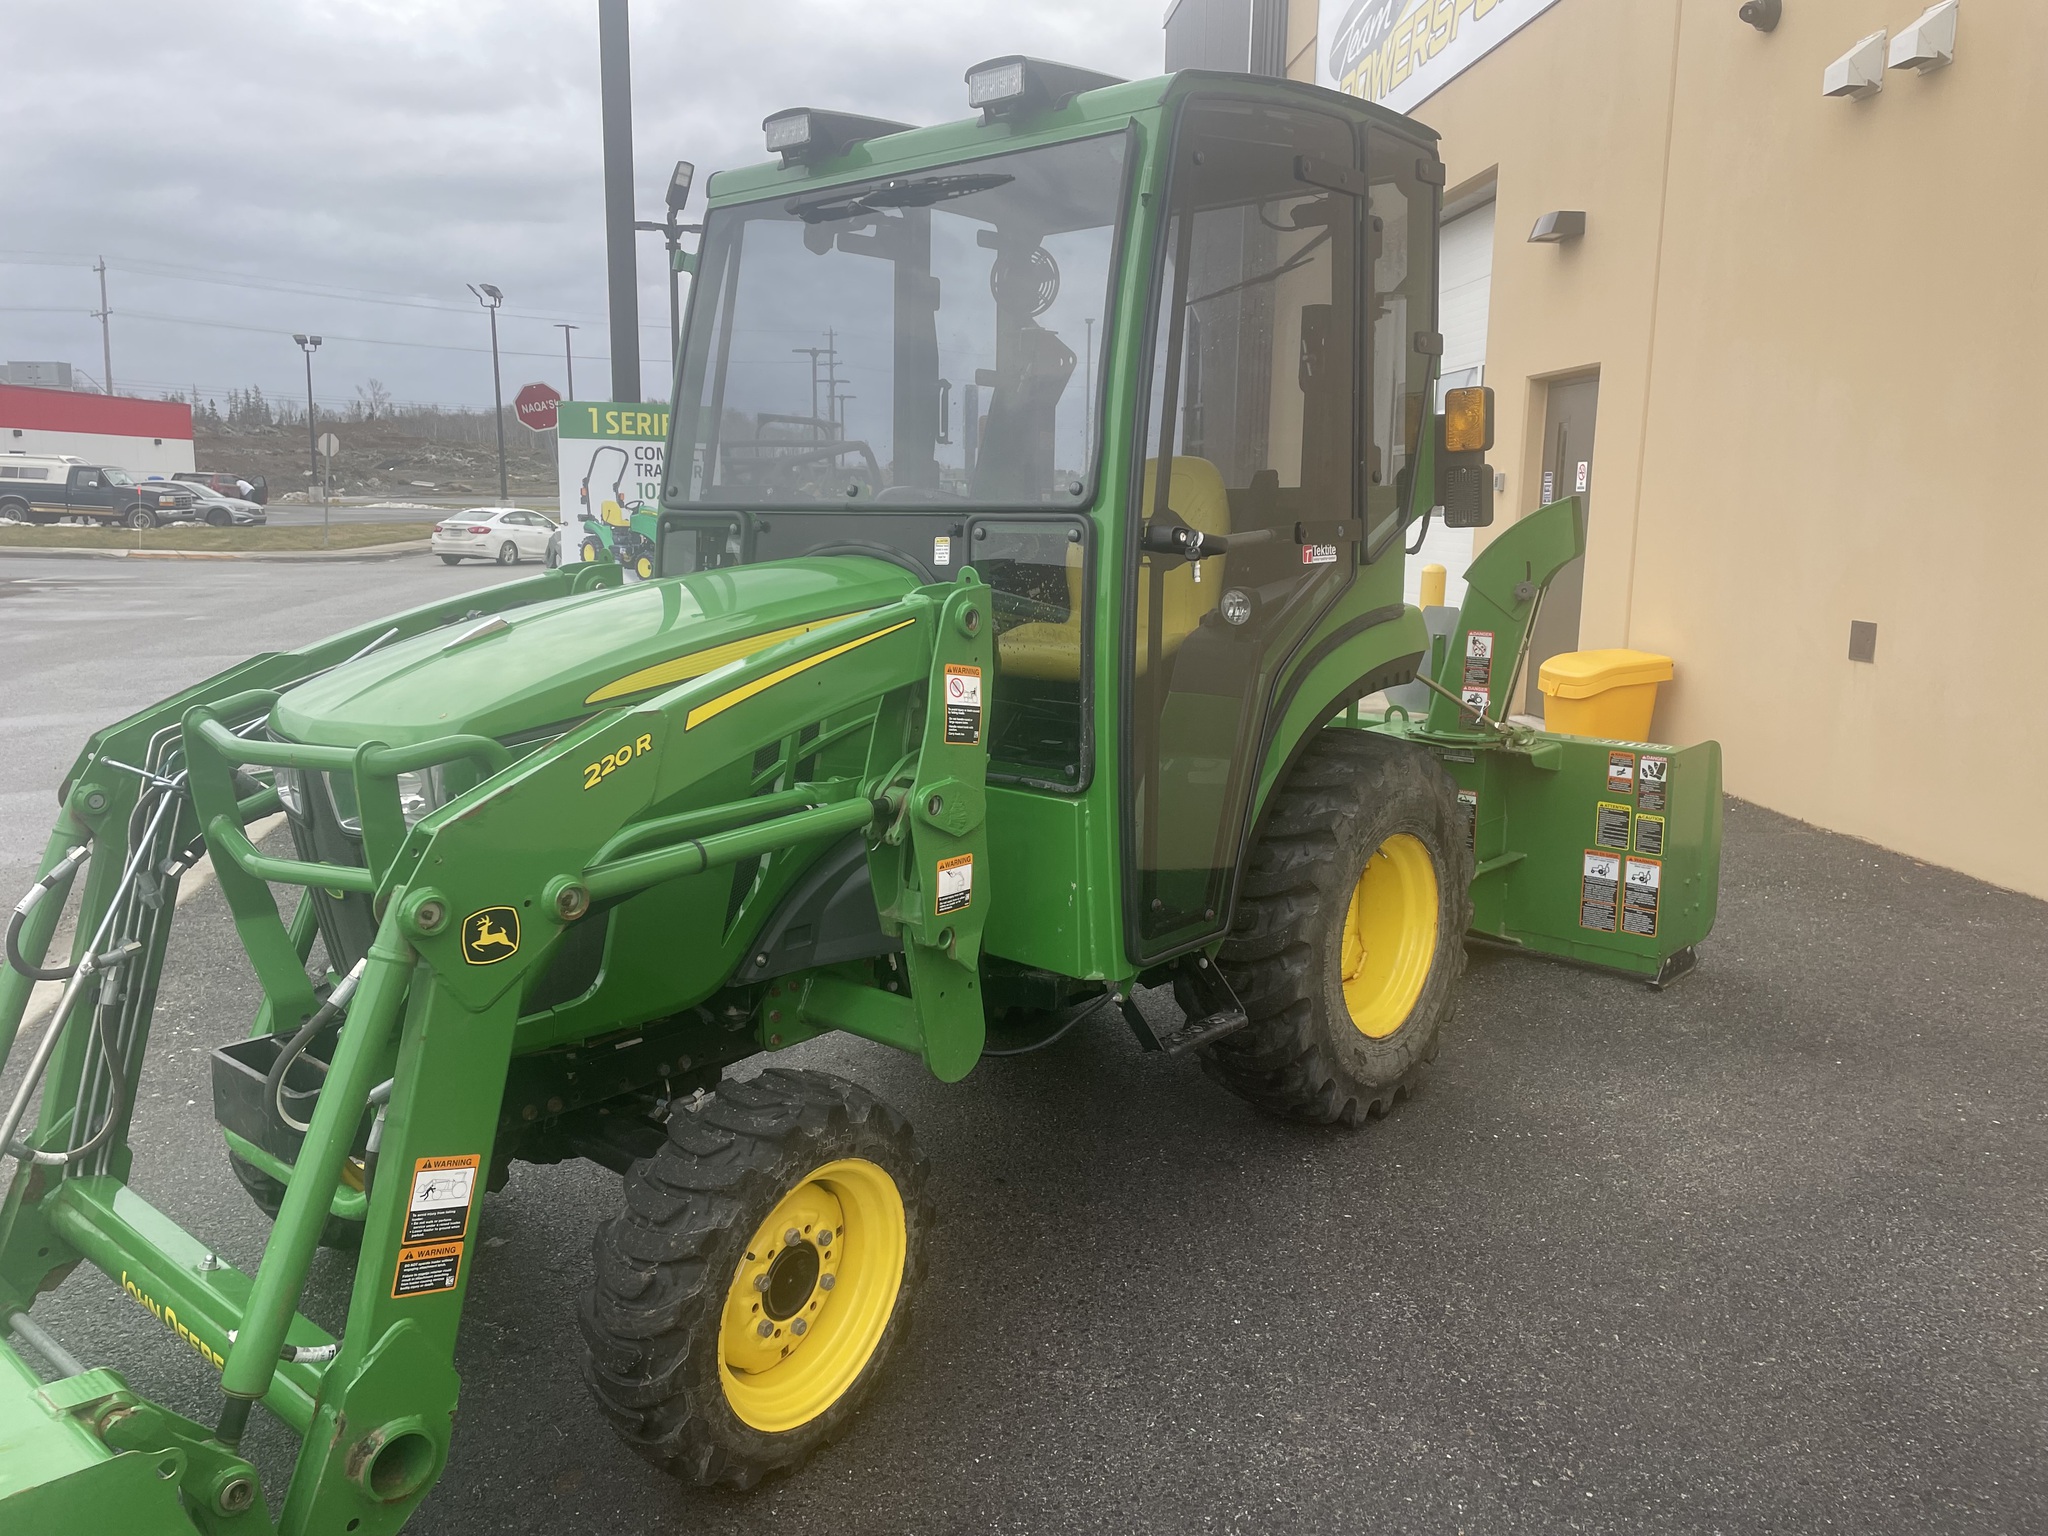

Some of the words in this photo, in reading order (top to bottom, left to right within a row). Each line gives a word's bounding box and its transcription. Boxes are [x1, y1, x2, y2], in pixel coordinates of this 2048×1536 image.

[1331, 0, 1392, 80] Team
[588, 408, 598, 434] 1
[1313, 544, 1336, 556] Tektite
[953, 666, 980, 675] WARNING
[584, 745, 633, 791] 220
[636, 733, 652, 757] R
[945, 856, 971, 868] WARNING
[434, 1158, 472, 1168] WARNING
[417, 1247, 456, 1258] WARNING
[122, 1270, 162, 1320] JOHN
[164, 1306, 224, 1372] DEERE
